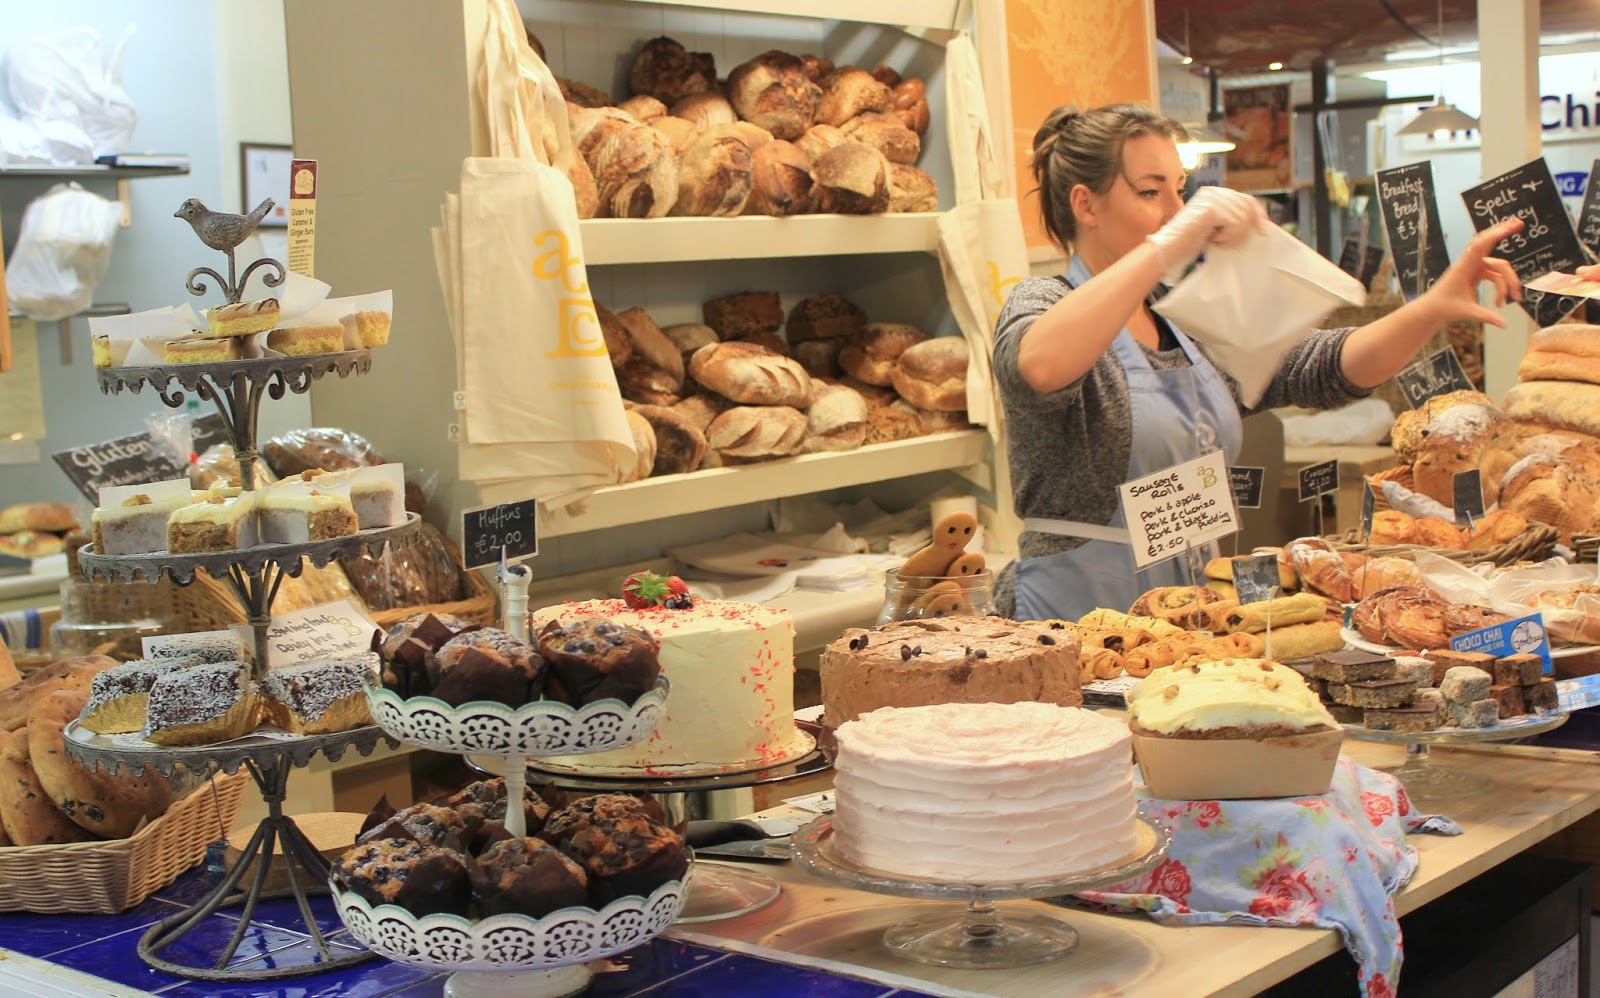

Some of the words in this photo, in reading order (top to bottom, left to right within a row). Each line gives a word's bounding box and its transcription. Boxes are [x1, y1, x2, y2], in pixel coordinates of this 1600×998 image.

[1382, 178, 1424, 200] Breakfast
[1393, 197, 1420, 219] Bread
[1474, 187, 1518, 217] Spelt
[1303, 463, 1334, 482] Croissant
[1130, 472, 1179, 497] Sausage
[1151, 483, 1184, 500] Rolls
[1175, 492, 1202, 507] apple
[478, 504, 521, 529] Muffins
[1184, 511, 1208, 528] black
[1197, 510, 1232, 531] pudding
[474, 530, 522, 554] €2.00
[1455, 633, 1481, 651] CHOCO
[1483, 626, 1503, 644] CHAI
